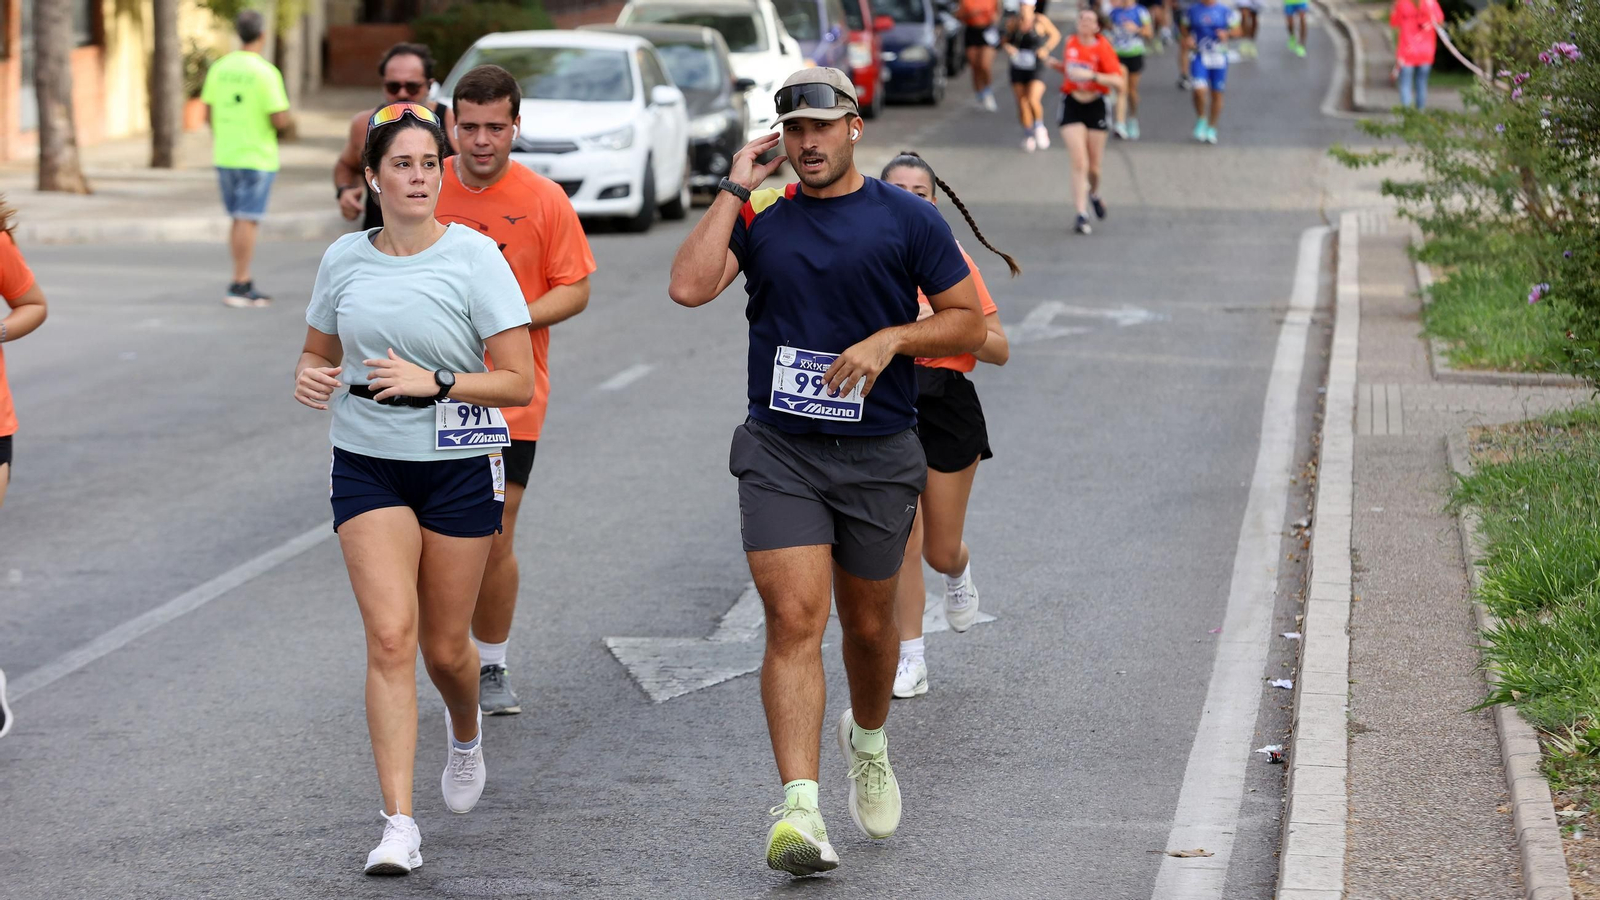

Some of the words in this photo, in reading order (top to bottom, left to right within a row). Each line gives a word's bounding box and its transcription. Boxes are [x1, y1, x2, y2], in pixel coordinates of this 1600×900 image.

[457, 404, 492, 426] 991
[802, 403, 855, 417] MIZUNO
[467, 432, 506, 444] MIZUNO
